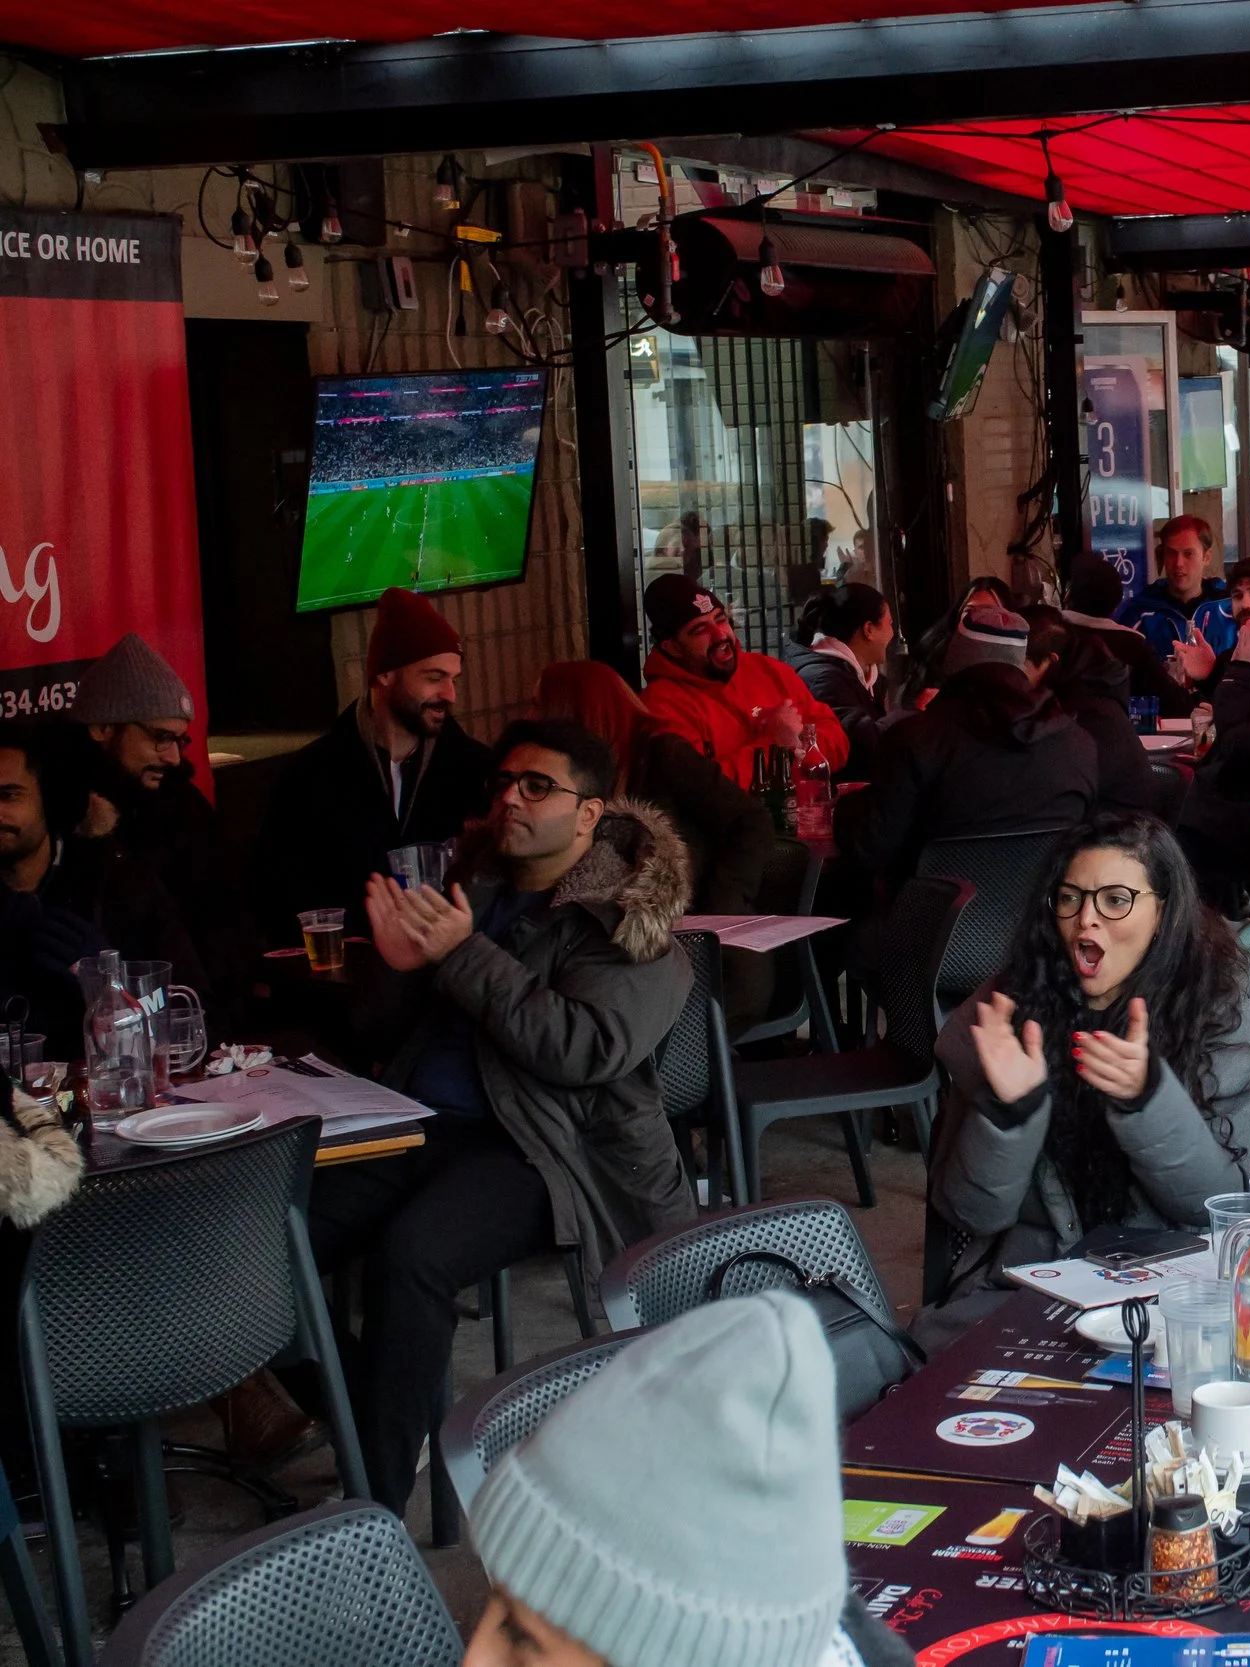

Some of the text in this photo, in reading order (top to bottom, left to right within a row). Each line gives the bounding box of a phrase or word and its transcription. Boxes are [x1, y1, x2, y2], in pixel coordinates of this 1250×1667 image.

[37, 233, 70, 261] OR
[76, 236, 141, 264] HOME
[1097, 422, 1115, 477] 3
[1090, 493, 1139, 528] PEED
[847, 1540, 891, 1550] NON-AL
[866, 1584, 912, 1618] DAIL
[930, 1632, 992, 1659] YOU
